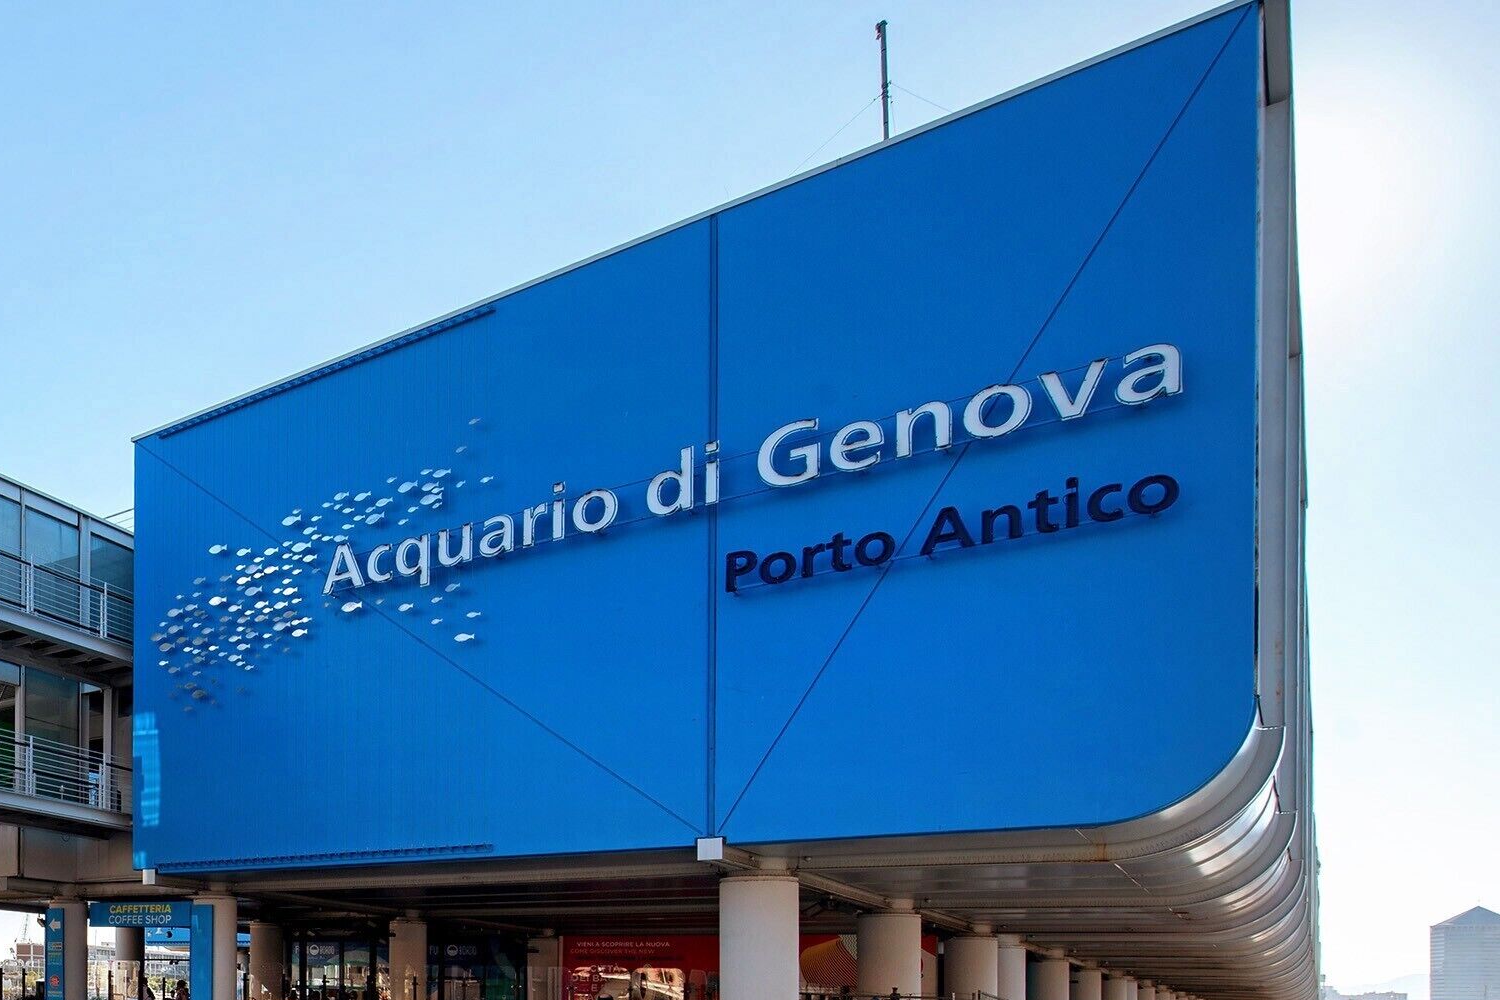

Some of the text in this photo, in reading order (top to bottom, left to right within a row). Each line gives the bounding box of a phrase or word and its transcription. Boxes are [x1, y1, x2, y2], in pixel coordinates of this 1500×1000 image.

[322, 342, 1184, 596] Acquario di Genova
[725, 473, 1180, 593] Porto Antico
[108, 915, 172, 924] COFFEE SHOP
[110, 904, 171, 913] CAFFETTERIA
